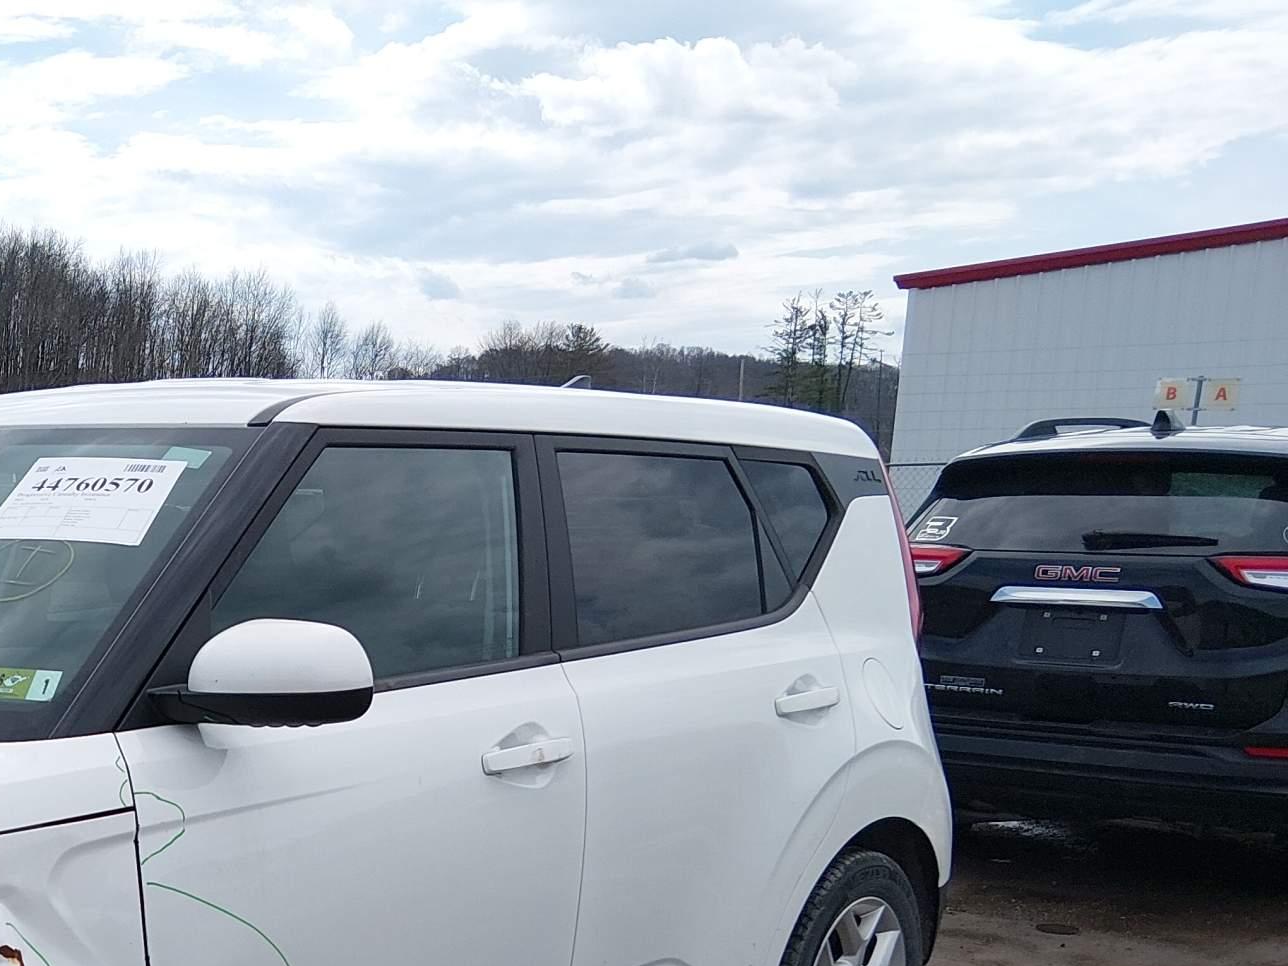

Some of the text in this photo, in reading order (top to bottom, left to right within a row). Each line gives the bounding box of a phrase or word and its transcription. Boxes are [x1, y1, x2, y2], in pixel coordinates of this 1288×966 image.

[1164, 386, 1177, 401] B
[1214, 387, 1228, 402] A
[31, 477, 154, 493] 44760570
[1033, 564, 1122, 583] GMC
[42, 679, 50, 695] 1
[923, 683, 1004, 695] TERRAIN
